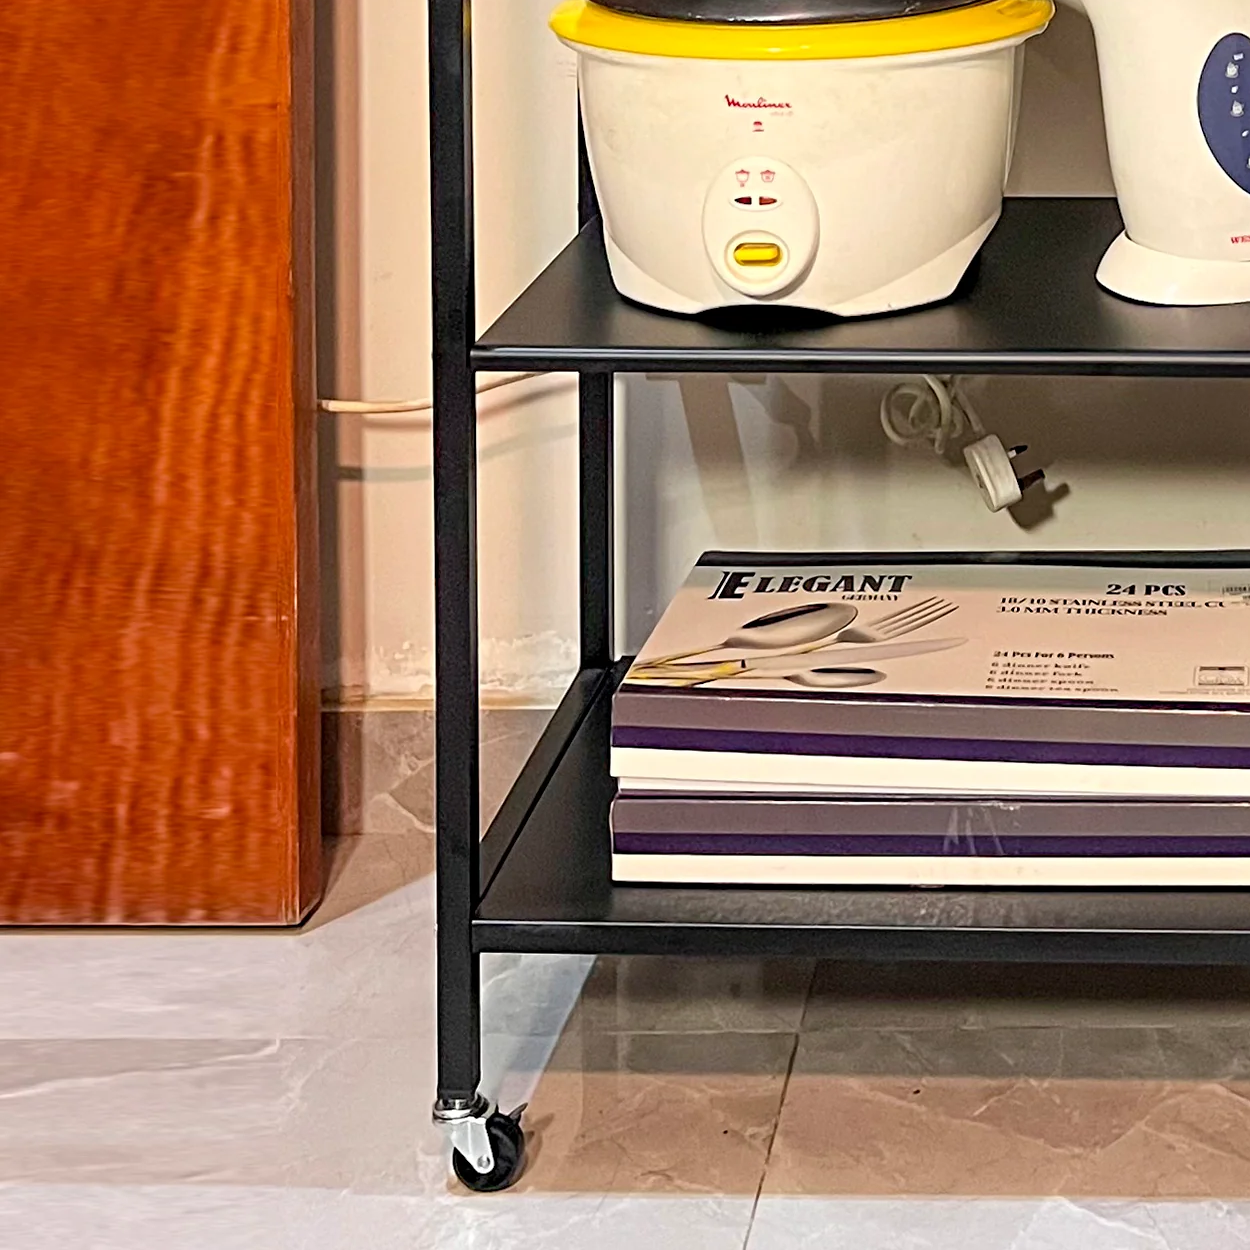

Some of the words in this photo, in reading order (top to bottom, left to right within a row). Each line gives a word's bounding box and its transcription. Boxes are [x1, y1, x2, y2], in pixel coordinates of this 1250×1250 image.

[725, 94, 792, 108] Moulinex
[707, 571, 912, 600] ELEGANT
[1106, 584, 1137, 596] 24
[1144, 584, 1187, 596] PCS
[1001, 597, 1046, 605] 18/10
[1050, 598, 1142, 607] STAINLESS
[1147, 600, 1203, 608] STEEL
[1024, 607, 1059, 615] MM
[1065, 607, 1168, 616] THICKNESS
[993, 650, 1009, 658] 24
